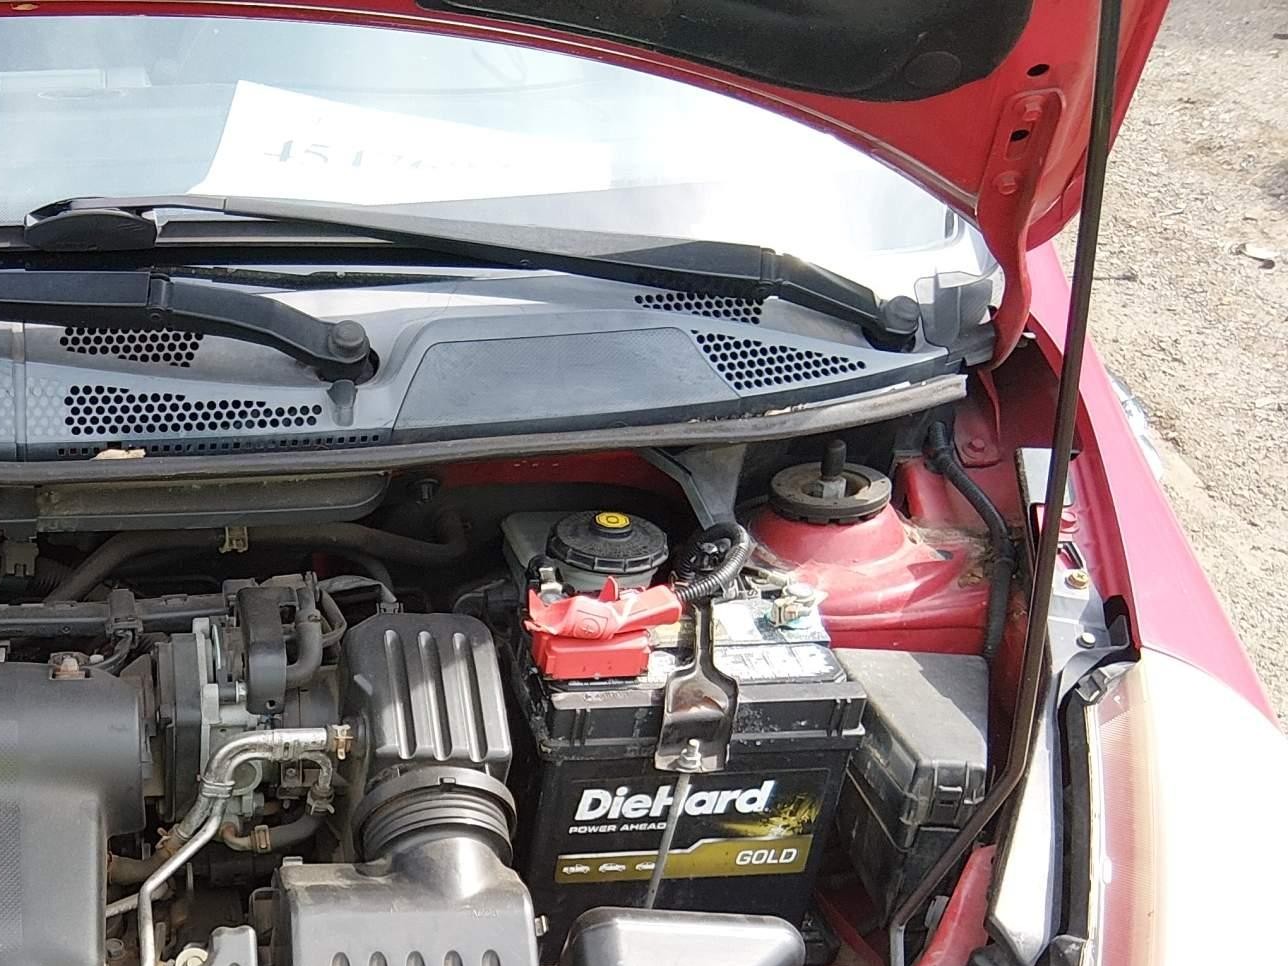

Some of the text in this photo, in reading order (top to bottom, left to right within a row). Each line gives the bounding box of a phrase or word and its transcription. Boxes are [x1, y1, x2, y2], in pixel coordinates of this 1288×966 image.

[575, 780, 776, 822] DieHard
[568, 822, 667, 835] POWER AHEAD
[735, 848, 798, 866] GOLD
